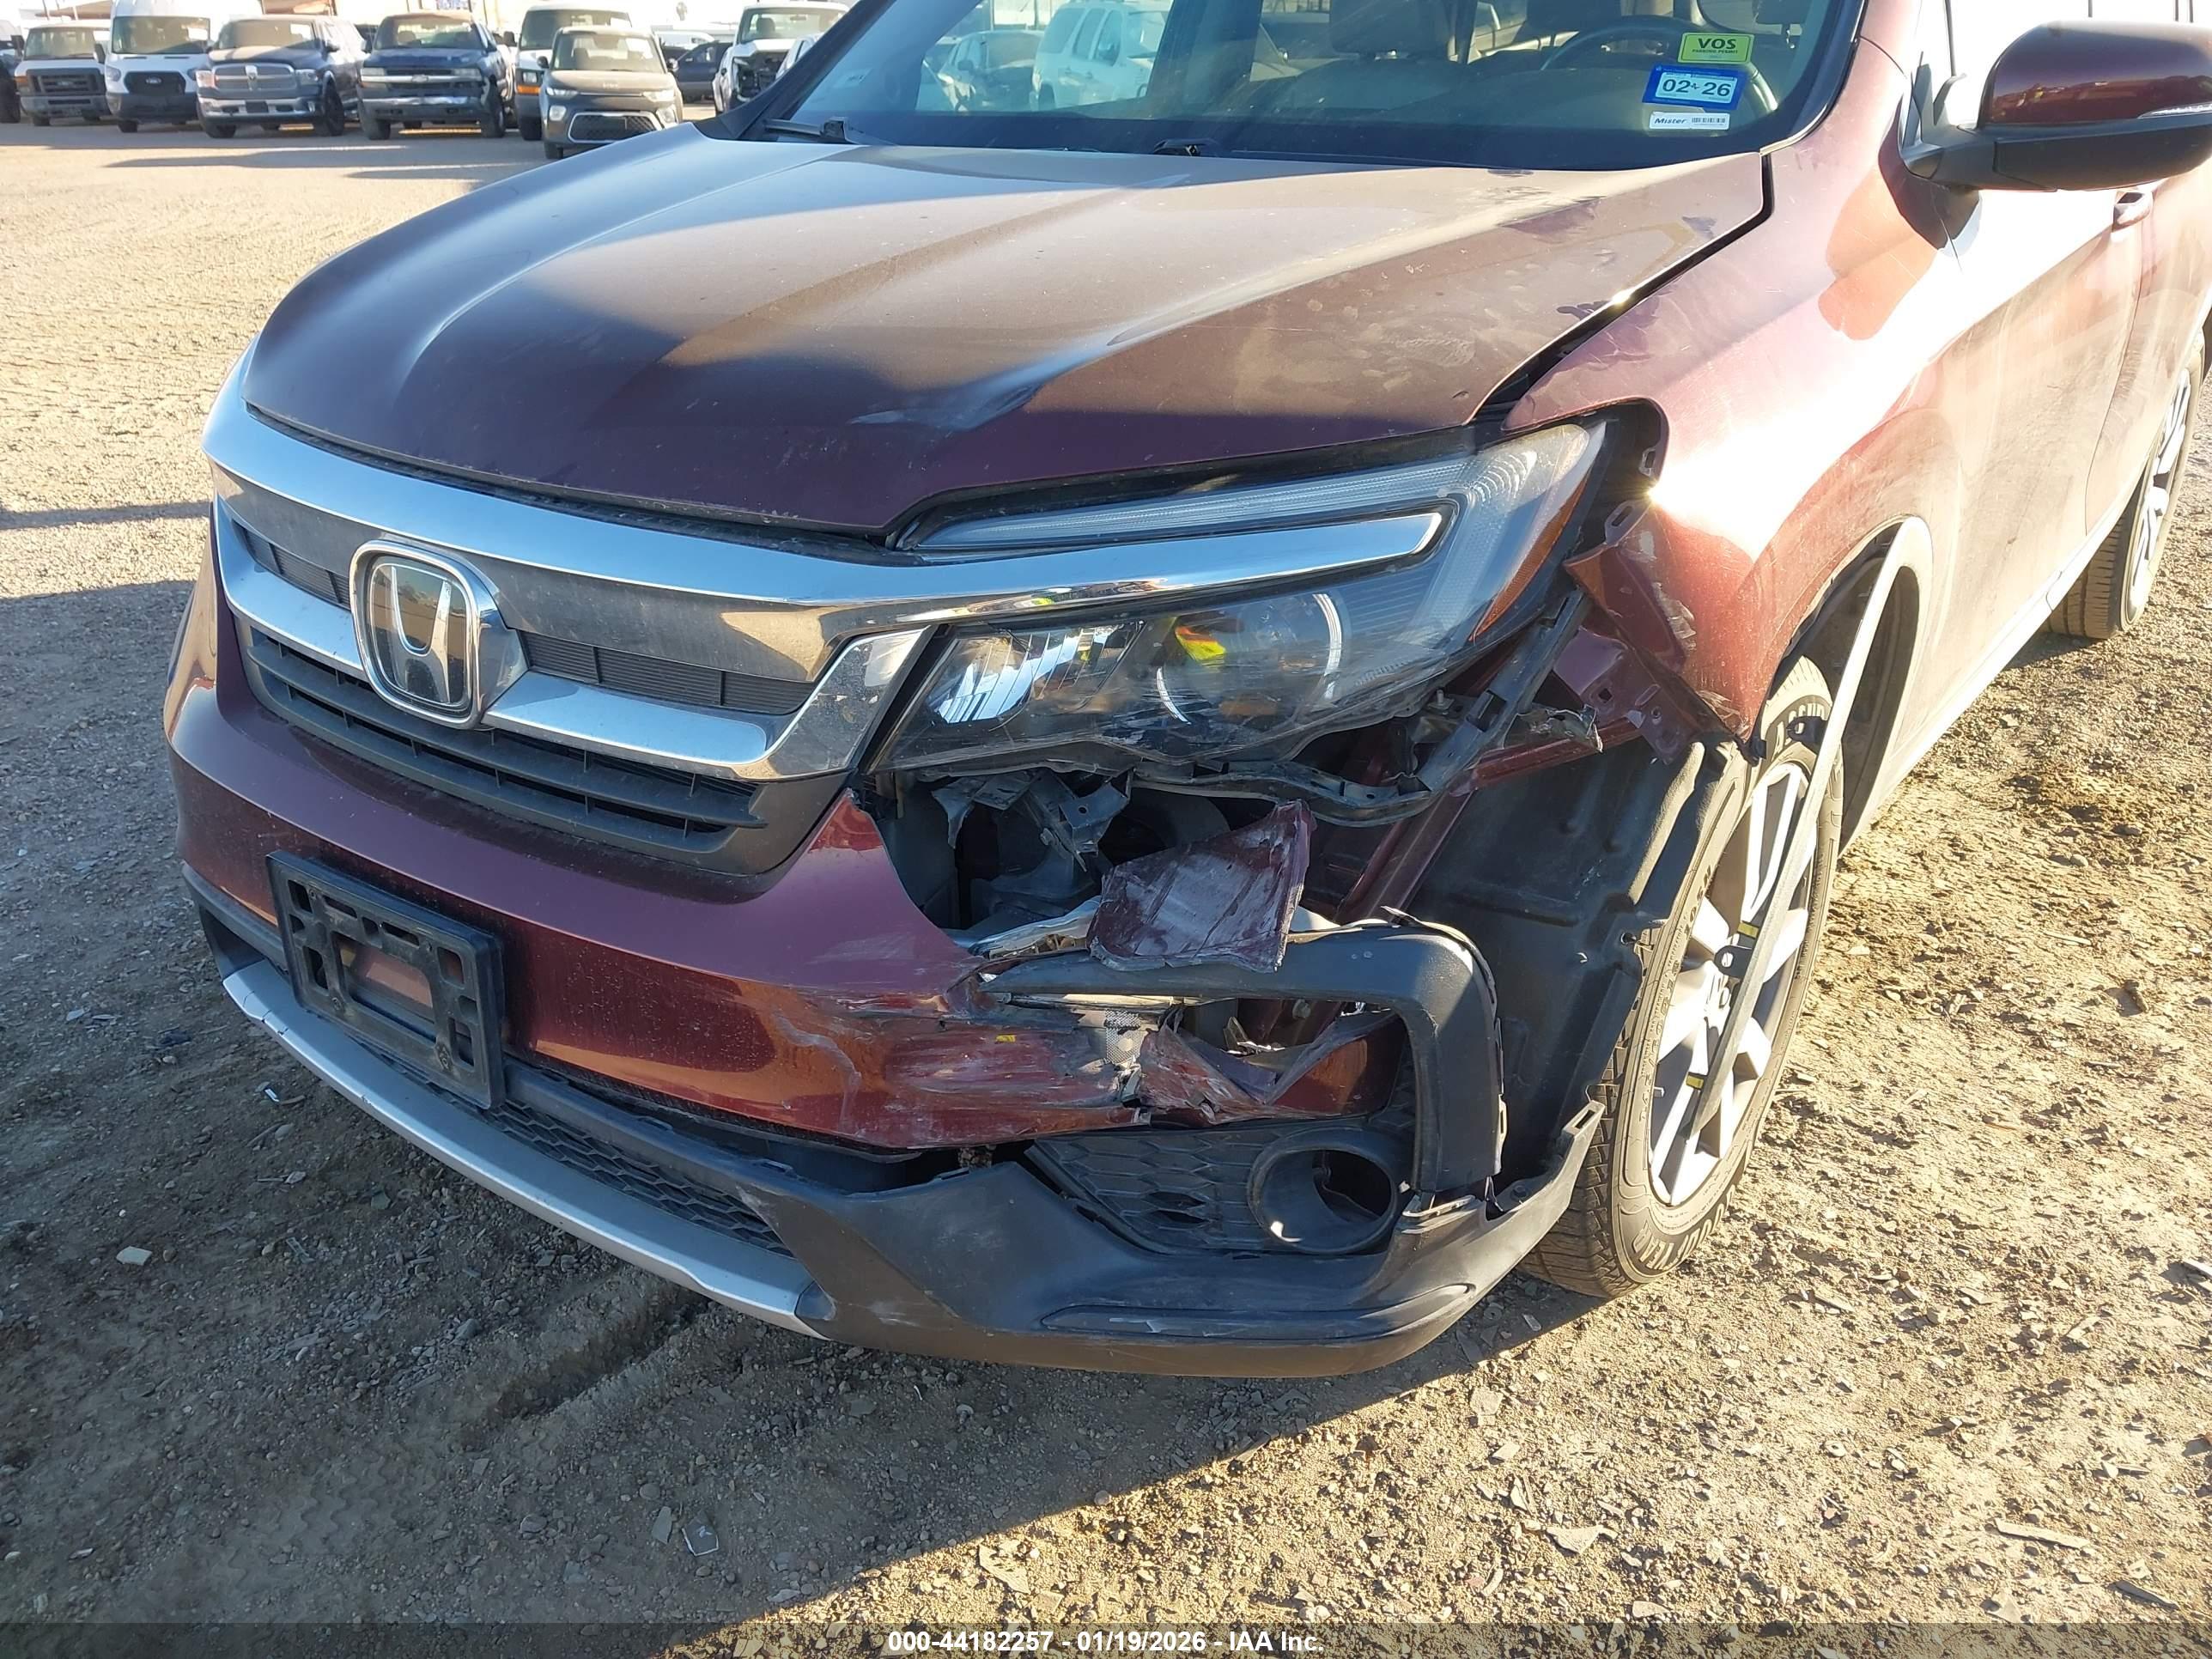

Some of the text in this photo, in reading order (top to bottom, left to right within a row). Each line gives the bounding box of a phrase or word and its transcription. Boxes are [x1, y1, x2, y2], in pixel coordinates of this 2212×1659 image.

[1698, 38, 1736, 49] VOS
[1662, 79, 1732, 96] 02 26
